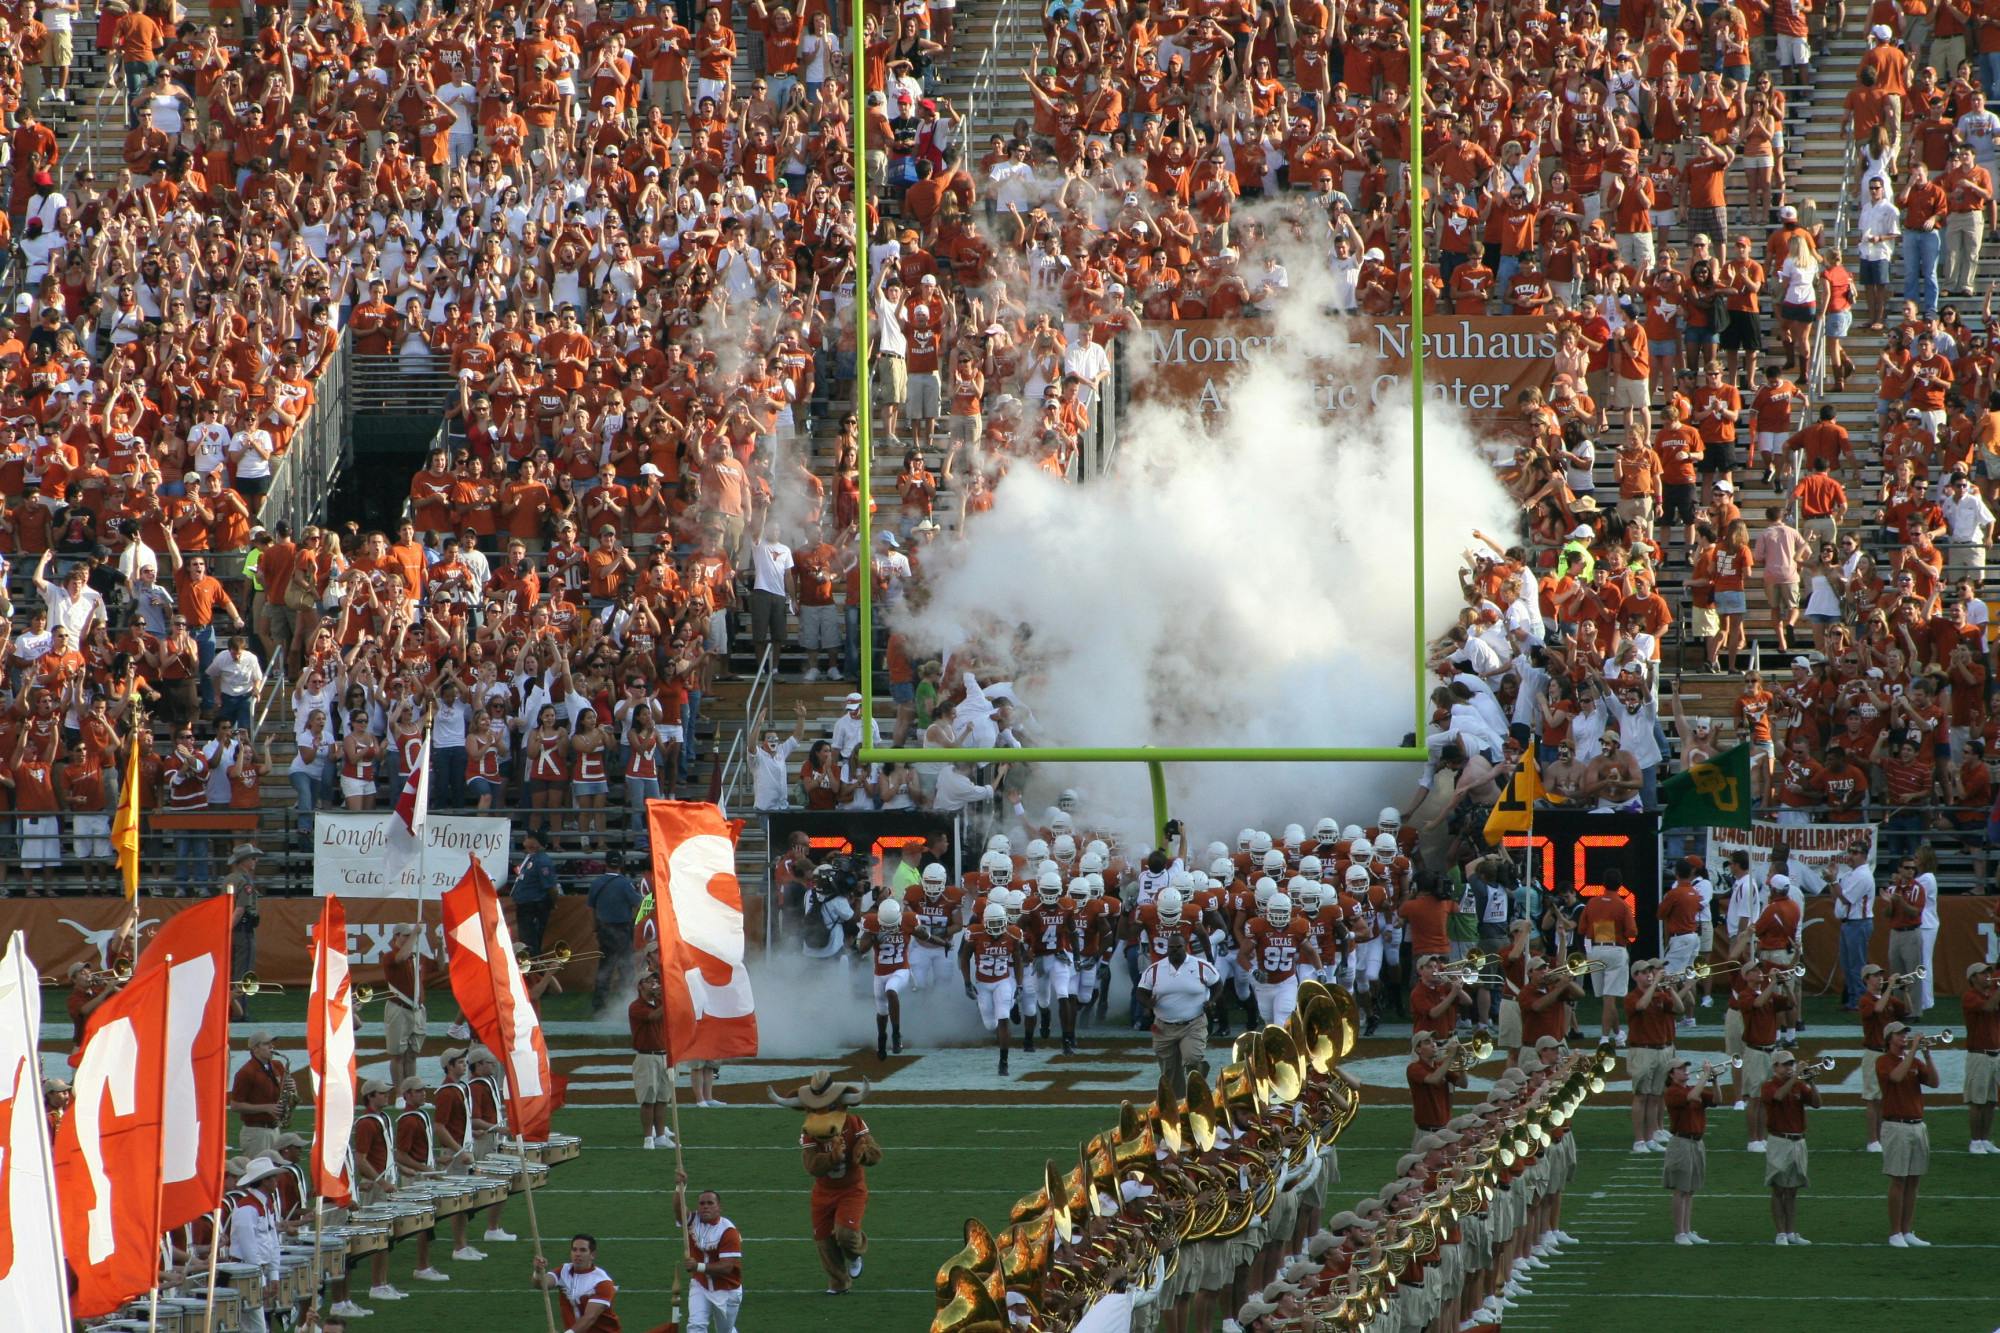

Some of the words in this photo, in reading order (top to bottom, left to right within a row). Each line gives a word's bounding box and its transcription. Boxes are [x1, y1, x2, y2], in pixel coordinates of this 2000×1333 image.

[1515, 285, 1539, 294] TEXAS
[1371, 374, 1510, 409] Cnter
[540, 396, 560, 404] TEXAS
[565, 568, 579, 590] 10
[1828, 779, 1854, 791] TEXAS
[427, 824, 504, 857] Honeys
[1799, 854, 1829, 866] Orange
[401, 868, 426, 885] the
[923, 907, 943, 916] TEXAS
[1043, 916, 1063, 924] TEXAS
[1041, 924, 1056, 949] 4
[1269, 937, 1292, 946] TEXAS
[880, 944, 903, 965] 21
[985, 946, 1008, 956] TEXAS
[1263, 947, 1297, 972] 95
